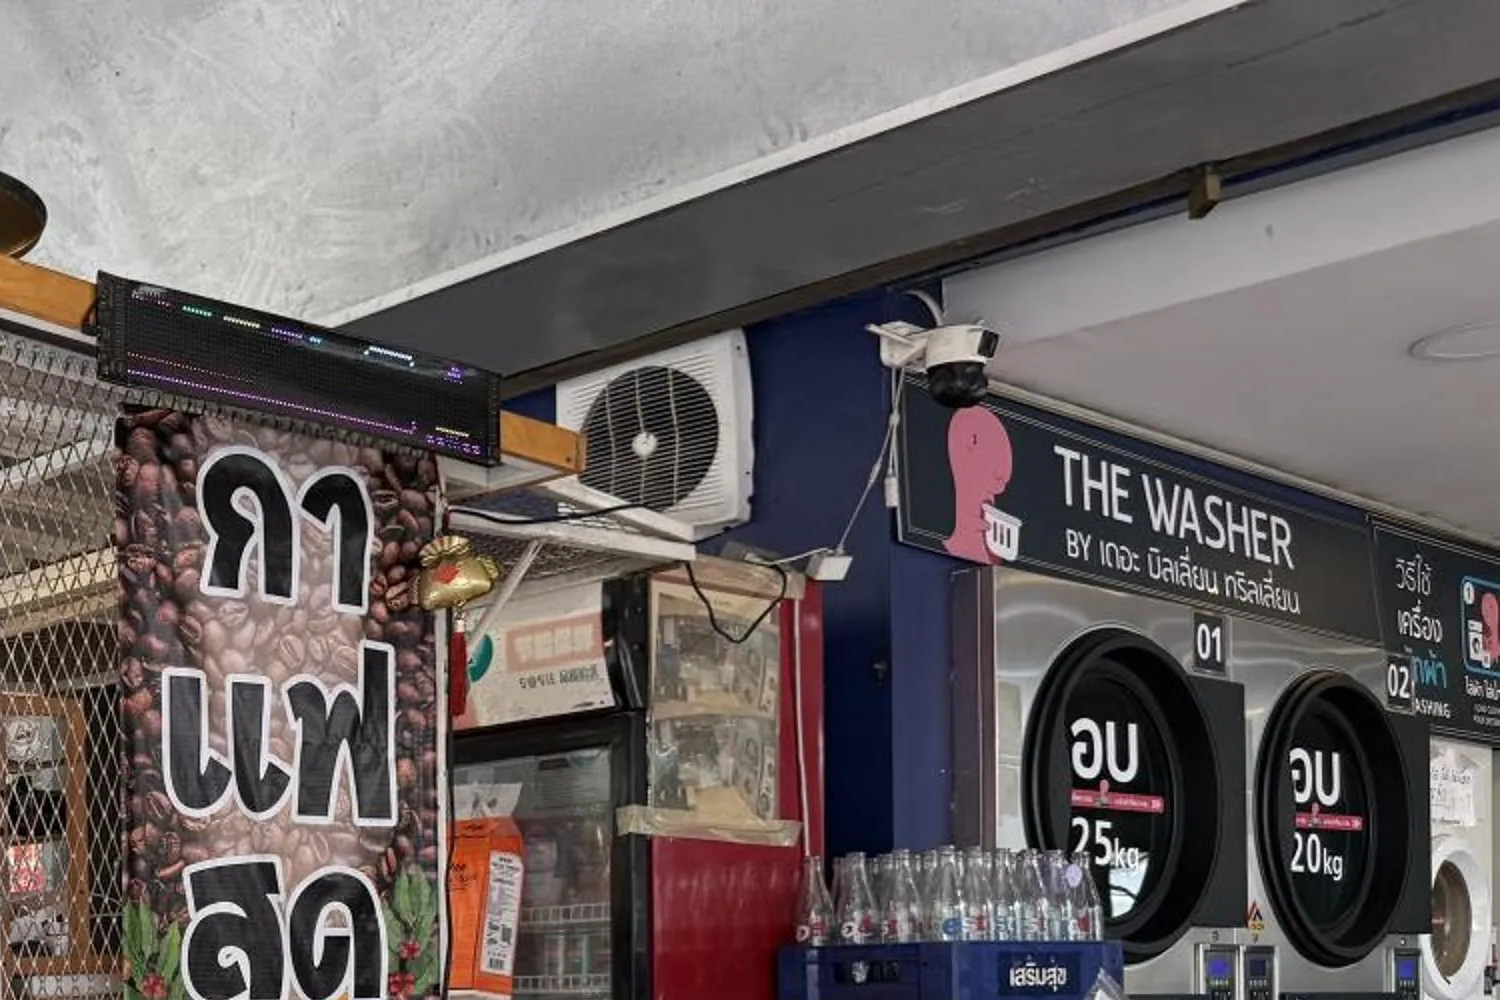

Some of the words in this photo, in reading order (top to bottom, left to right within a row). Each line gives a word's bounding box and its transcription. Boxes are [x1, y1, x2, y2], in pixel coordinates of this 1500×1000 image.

[197, 446, 373, 615] กา
[1054, 445, 1132, 524] THE
[1142, 473, 1295, 570] WASHER
[1065, 528, 1091, 561] BY
[1197, 623, 1222, 662] 01
[1387, 663, 1410, 698] 02
[162, 639, 398, 826] แฟ
[1414, 698, 1451, 718] ASHING
[1070, 717, 1139, 783] อบ
[1289, 747, 1341, 807] อบ
[1009, 954, 1068, 992] เสริมสุข
